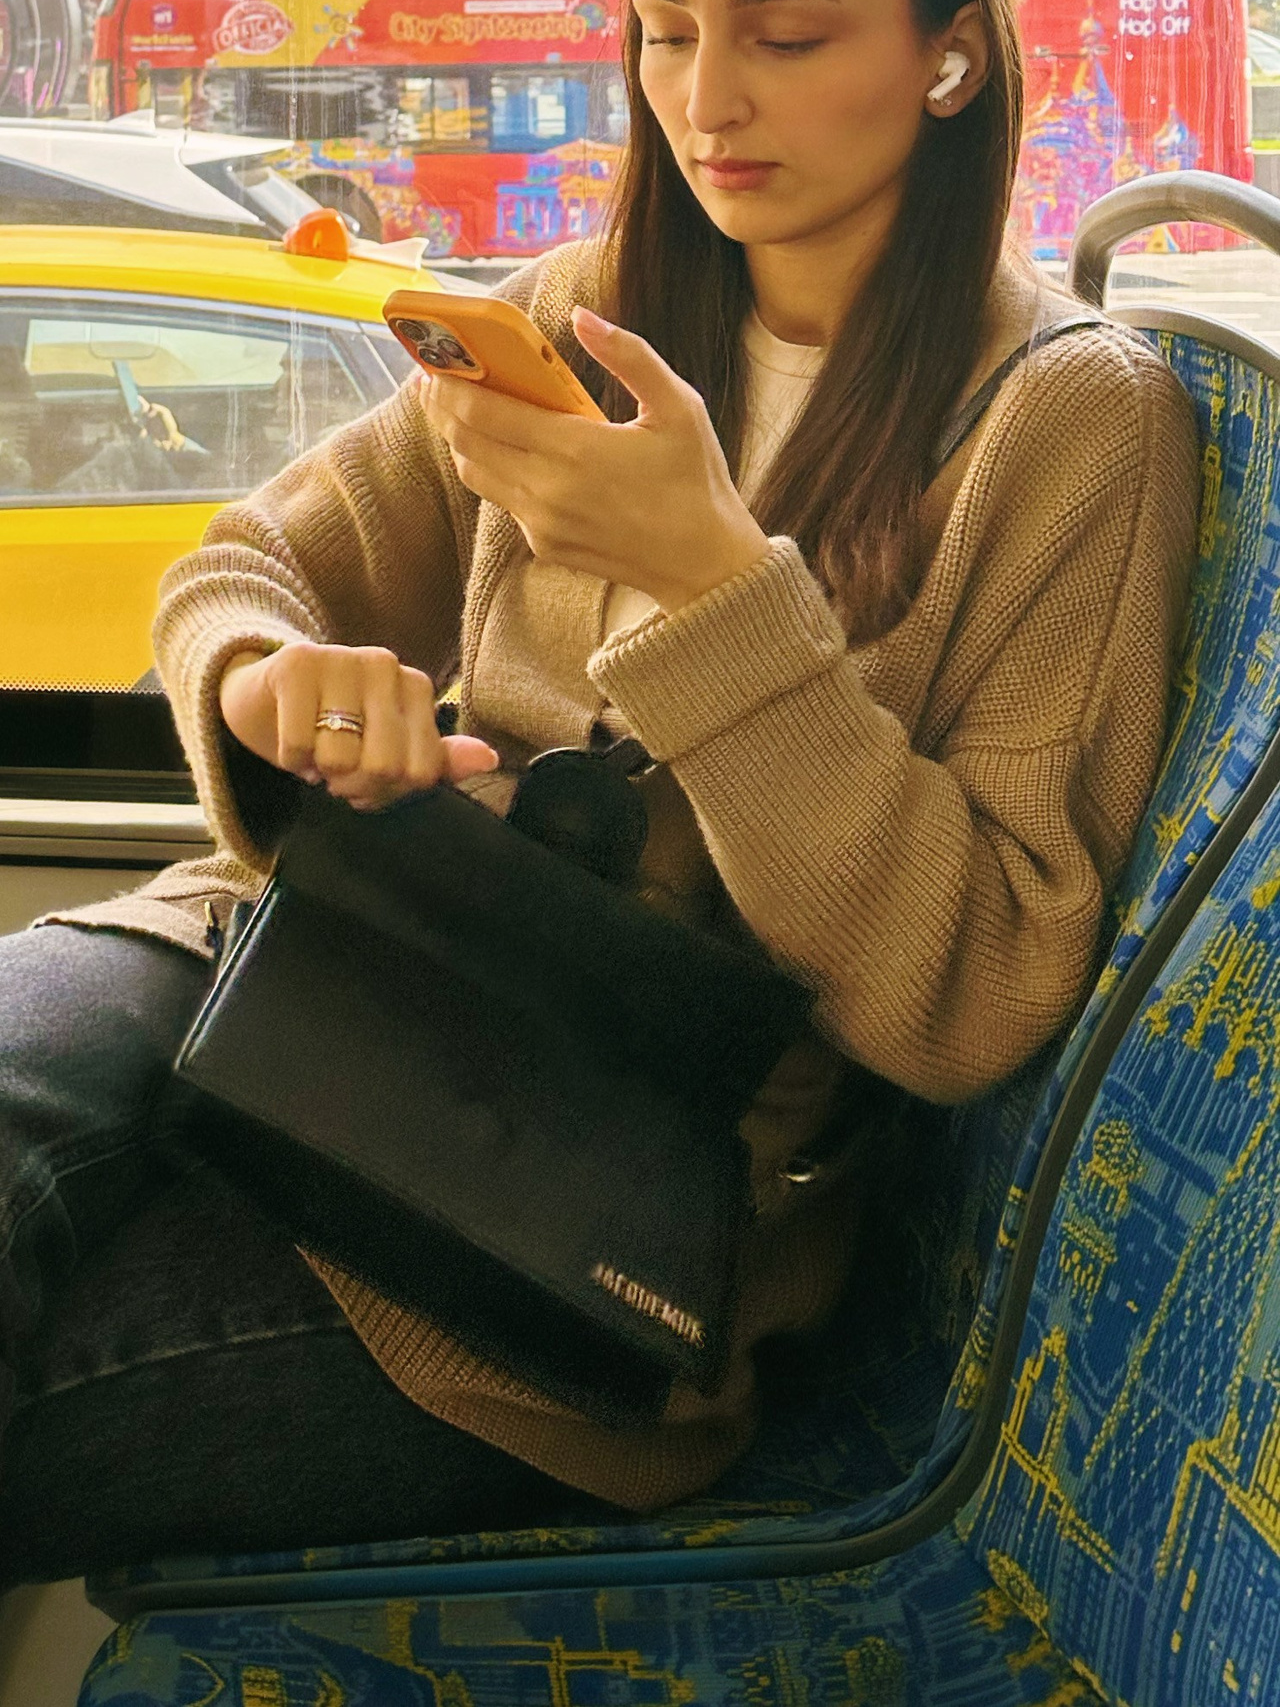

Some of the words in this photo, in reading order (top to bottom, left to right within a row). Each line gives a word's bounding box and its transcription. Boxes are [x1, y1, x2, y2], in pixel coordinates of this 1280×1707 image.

[389, 12, 439, 45] City
[1118, 16, 1157, 38] Hop
[1161, 14, 1191, 36] Off
